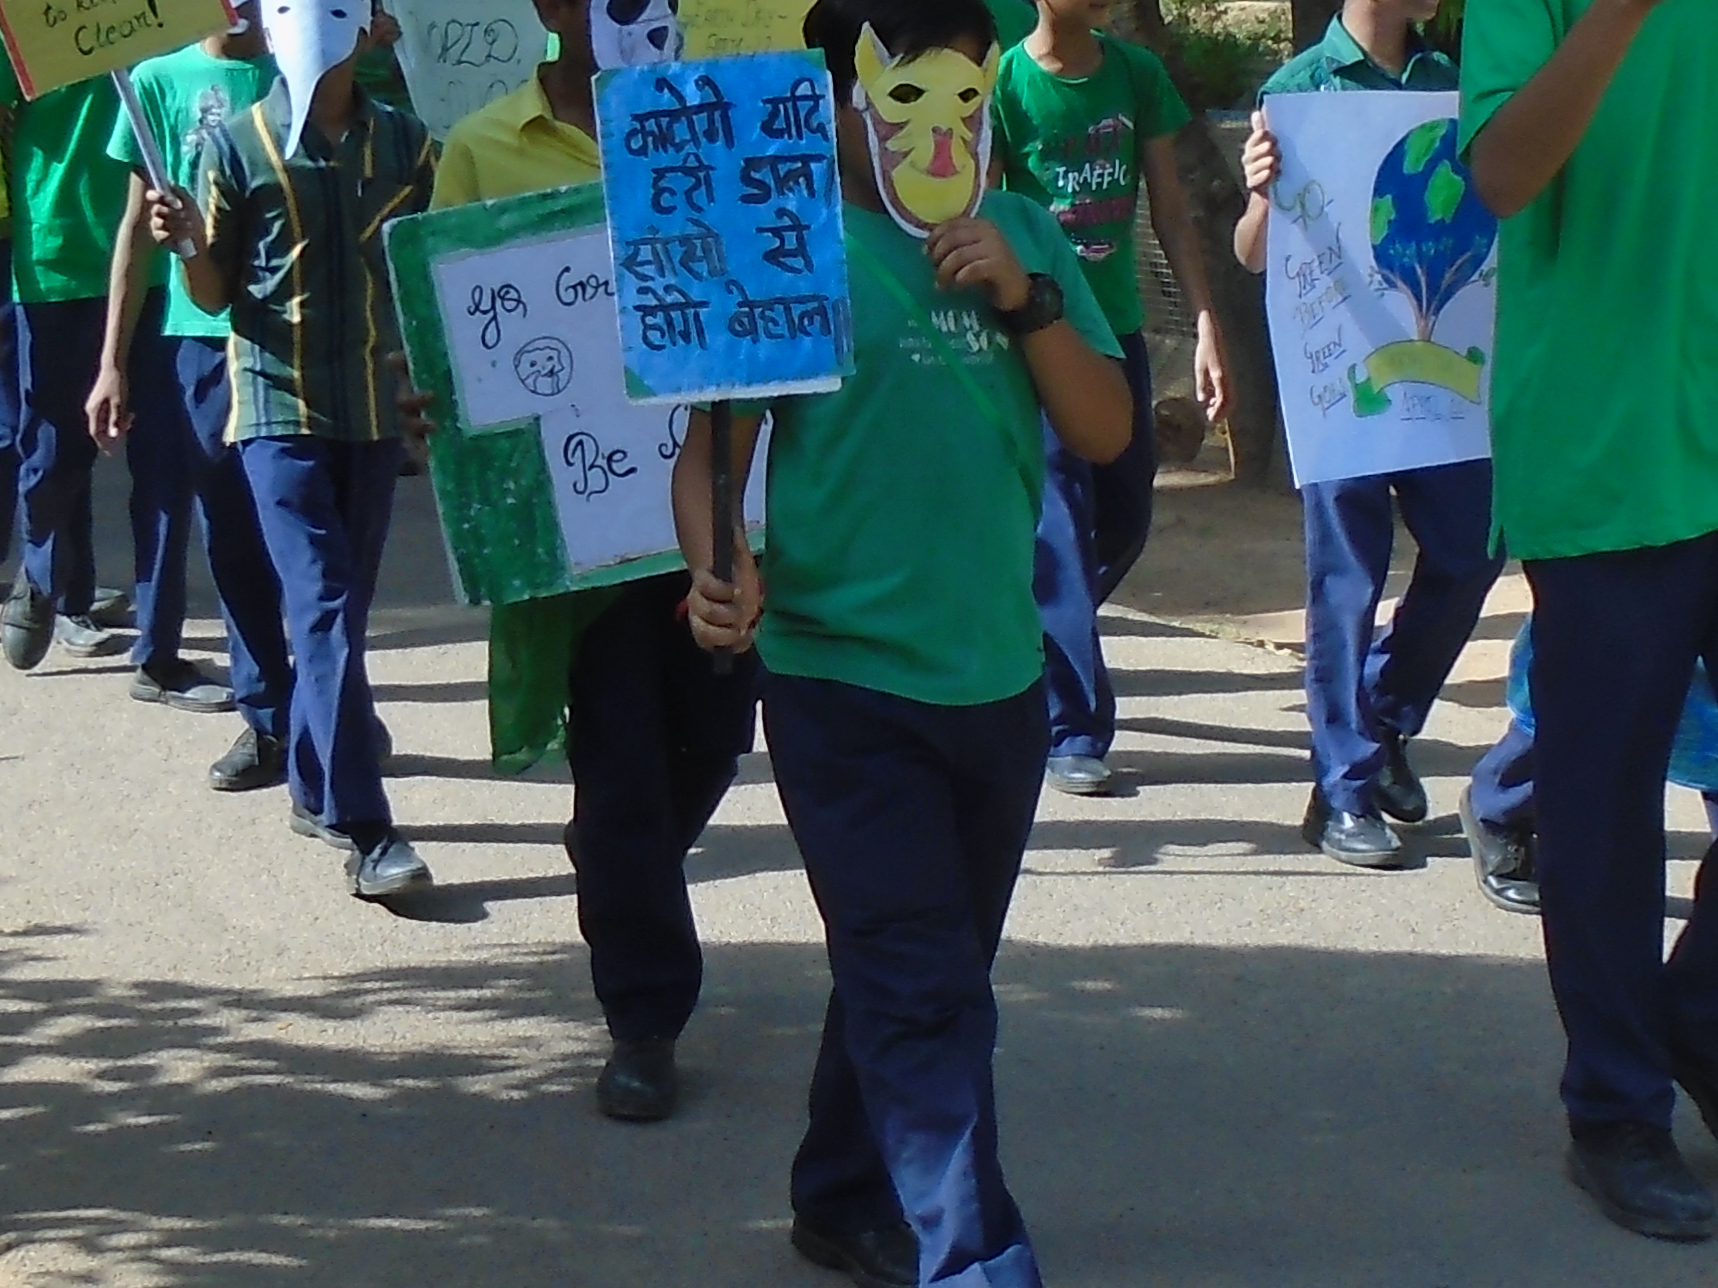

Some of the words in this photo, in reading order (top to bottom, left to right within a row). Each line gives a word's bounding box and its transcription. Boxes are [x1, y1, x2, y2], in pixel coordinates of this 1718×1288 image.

[42, 2, 67, 28] to
[760, 77, 829, 142] यदि
[650, 152, 716, 215] हरी
[1055, 159, 1127, 193] TRAFFIC
[755, 207, 814, 274] से
[1284, 221, 1343, 299] GREEN
[1304, 324, 1342, 373] GREEN
[563, 431, 638, 502] Be
